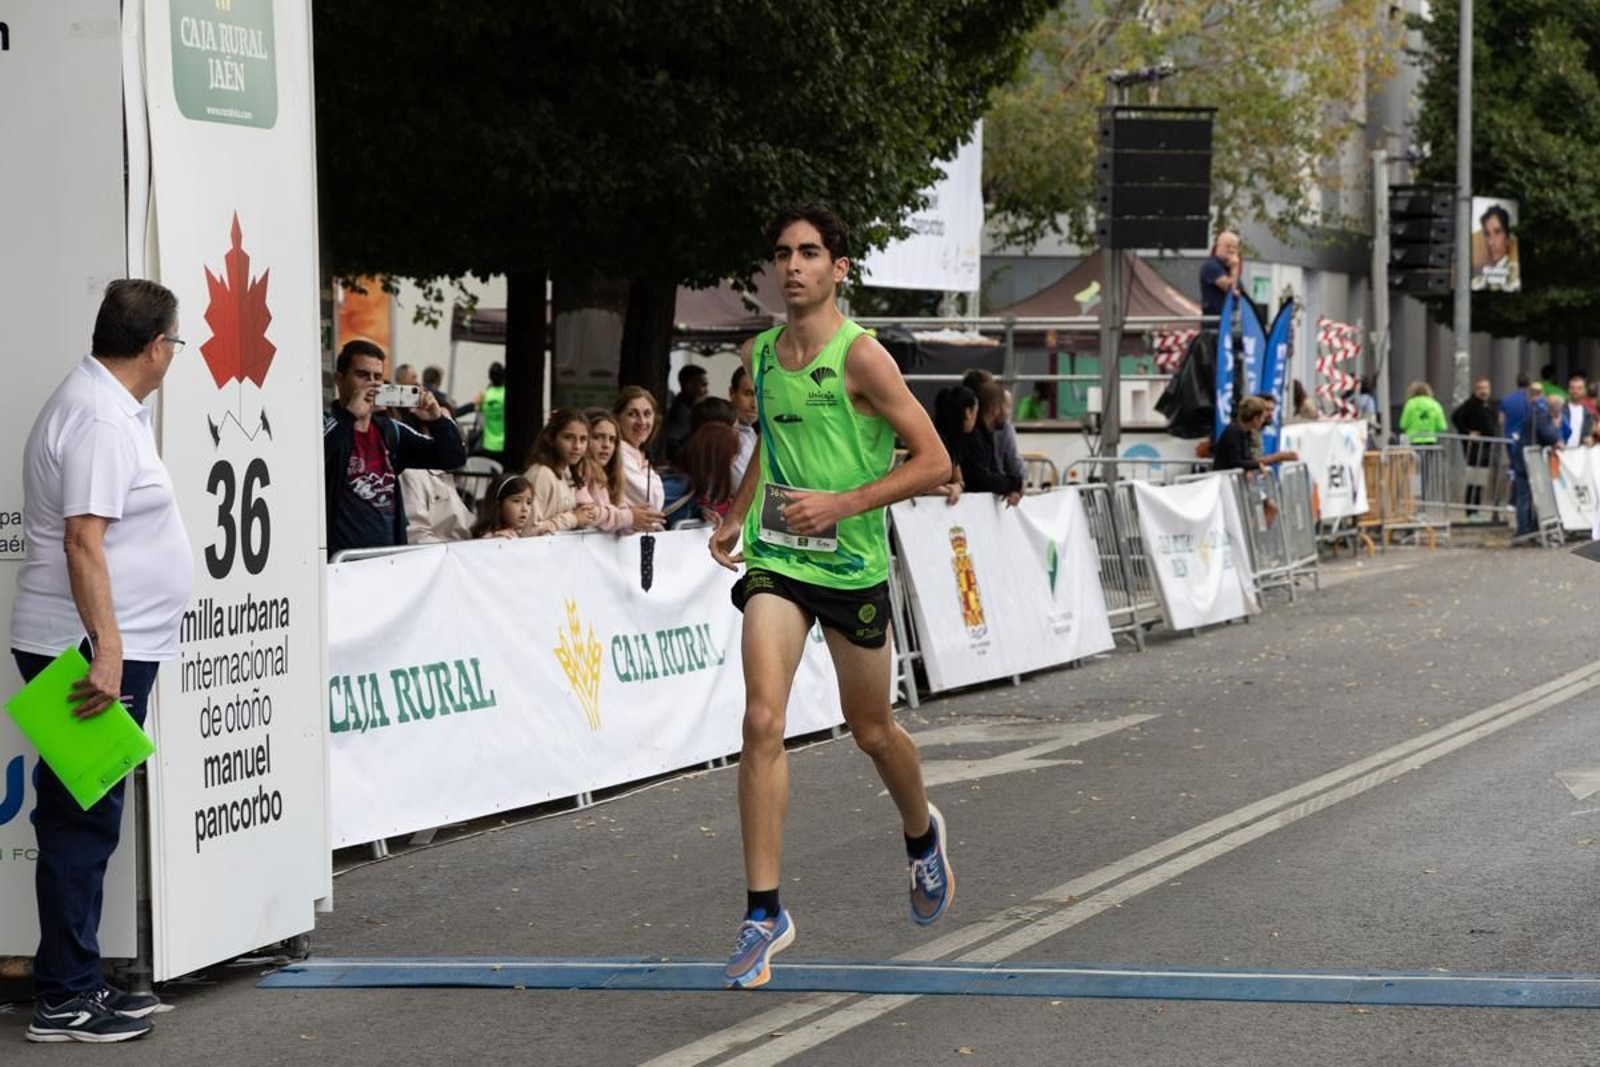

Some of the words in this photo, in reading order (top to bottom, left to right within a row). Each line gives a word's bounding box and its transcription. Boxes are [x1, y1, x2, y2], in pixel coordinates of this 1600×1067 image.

[181, 16, 218, 51] CAJA
[219, 22, 268, 60] RURAL
[208, 55, 245, 92] JAÉN
[204, 458, 270, 580] 36
[180, 597, 224, 643] milla
[228, 592, 289, 636] urbana
[182, 634, 288, 693] internacional
[611, 633, 659, 683] CAJA
[656, 623, 725, 677] RURAL
[200, 696, 222, 738] de
[225, 687, 272, 733] otoño
[329, 672, 391, 734] CAJA
[390, 657, 497, 724] RURAL
[204, 733, 271, 789] manuel
[195, 784, 282, 854] pancorbo
